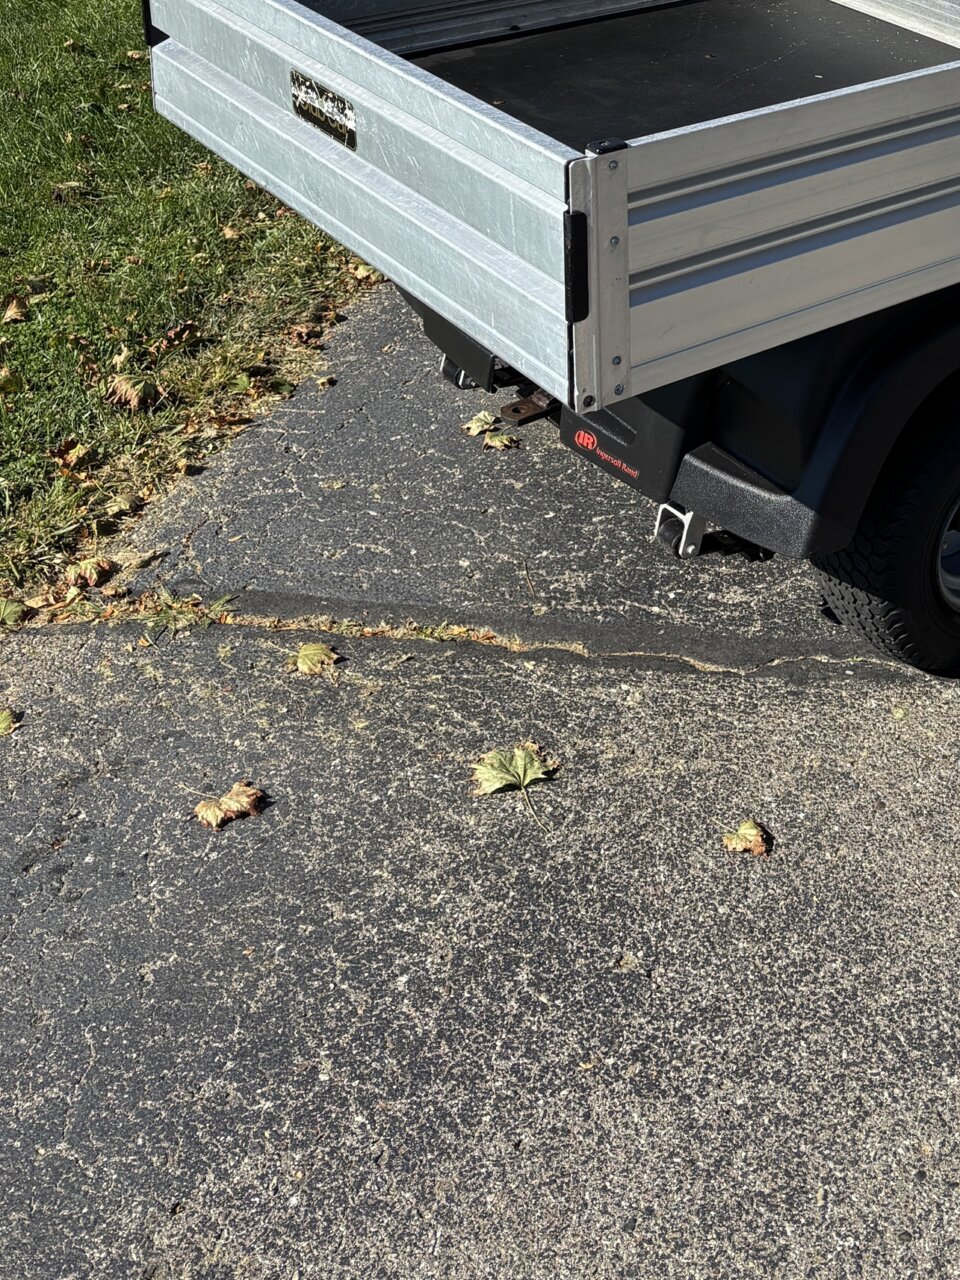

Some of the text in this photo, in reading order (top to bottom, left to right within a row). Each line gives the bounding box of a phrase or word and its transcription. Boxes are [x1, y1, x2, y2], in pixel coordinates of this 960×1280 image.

[577, 430, 595, 451] IR
[596, 447, 638, 478] Ingersoll Rand
